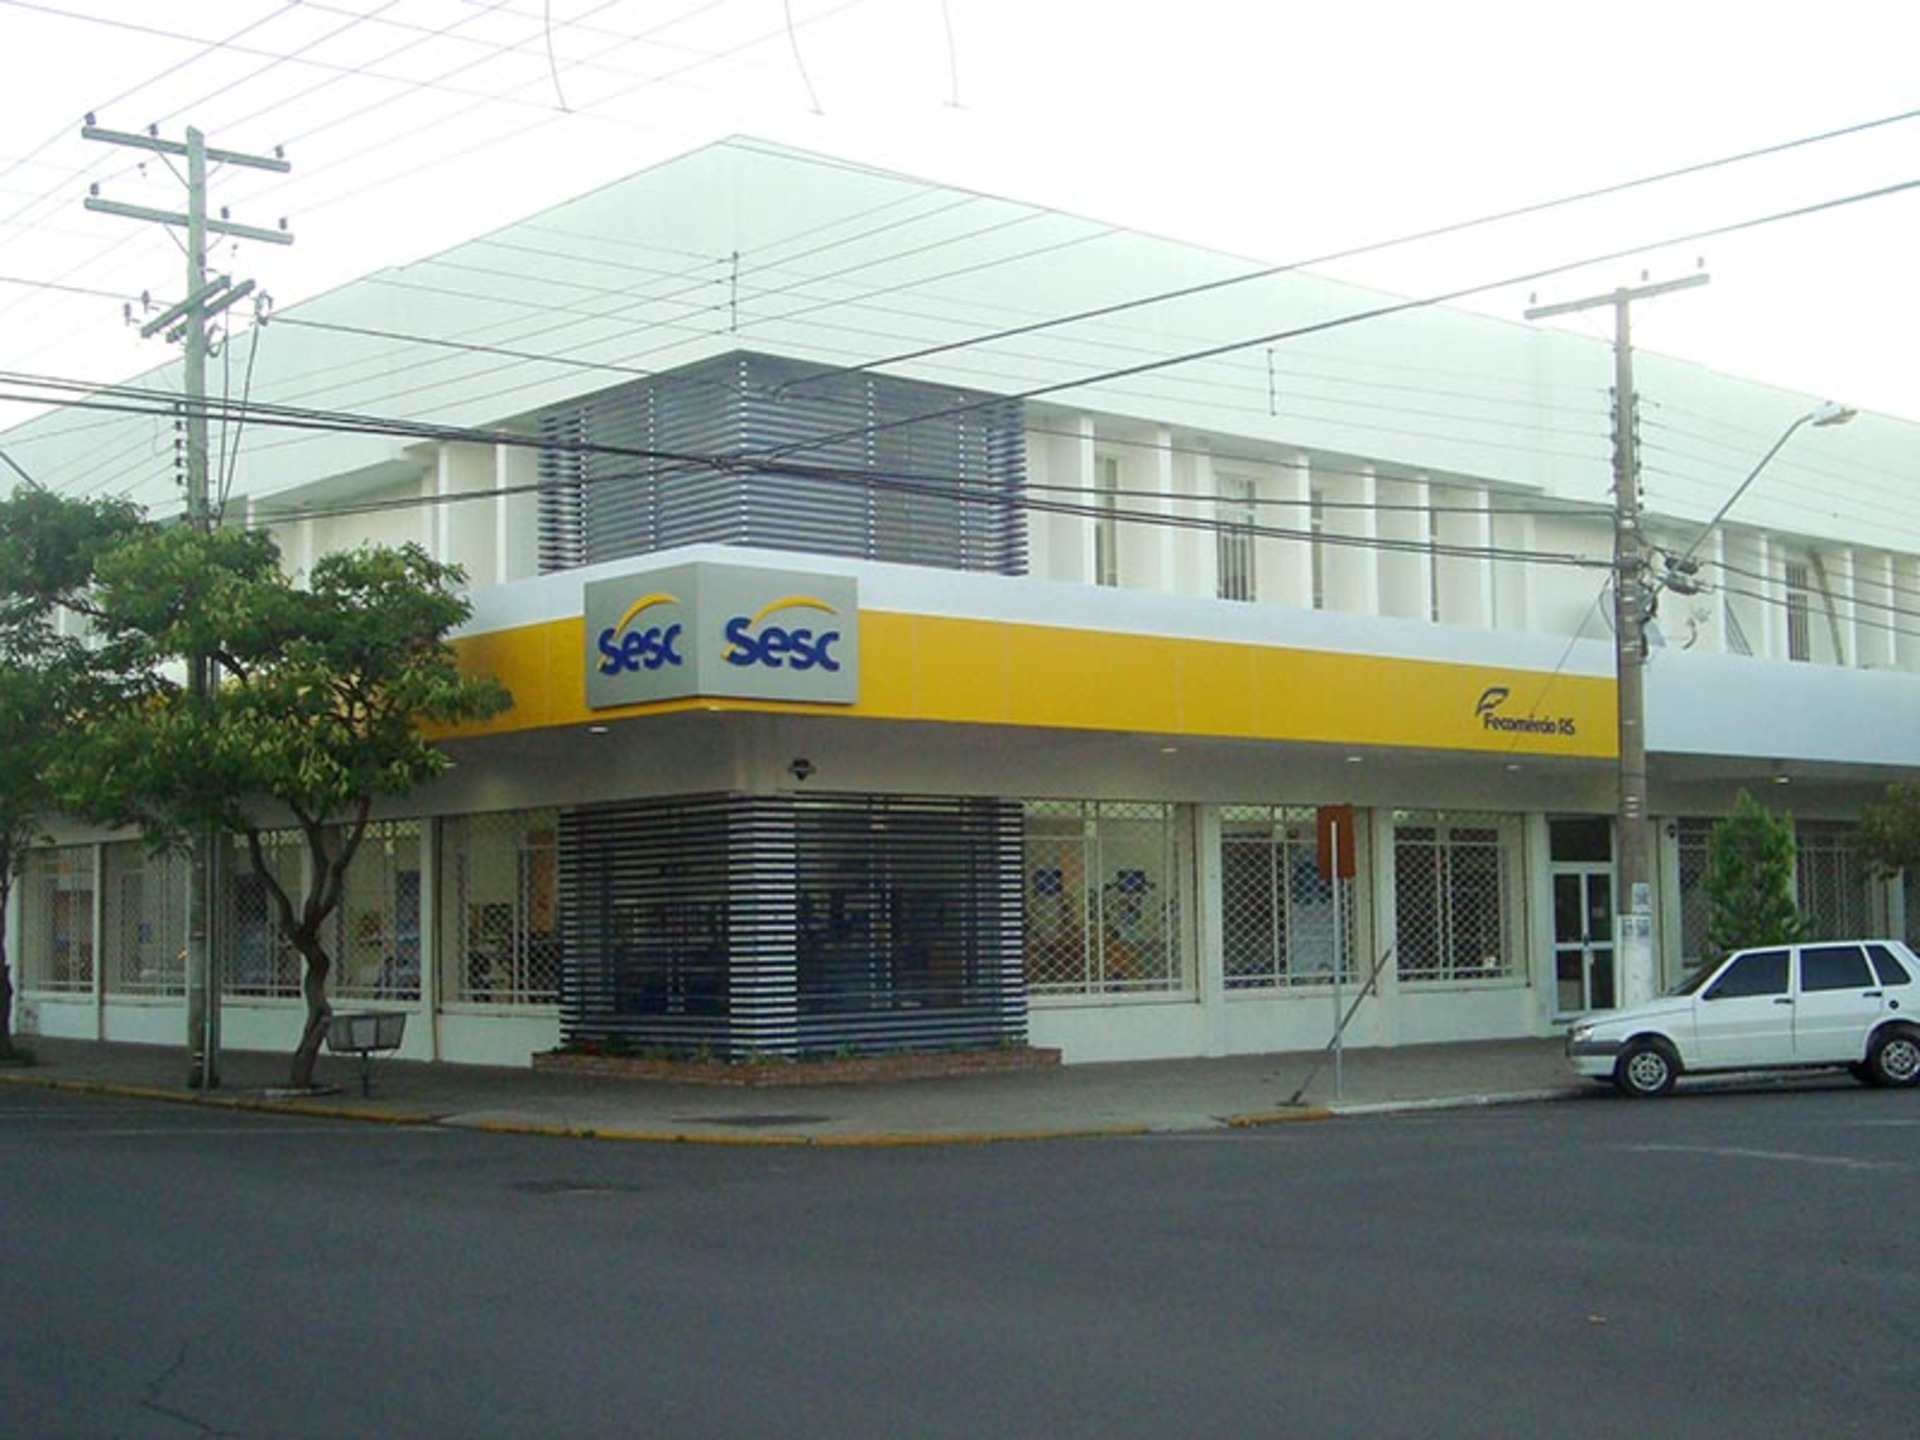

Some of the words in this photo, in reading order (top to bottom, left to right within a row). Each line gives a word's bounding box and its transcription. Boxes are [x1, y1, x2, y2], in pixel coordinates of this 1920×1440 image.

[598, 622, 683, 676] Sesc
[721, 616, 840, 672] Sesc
[1557, 716, 1576, 736] RS
